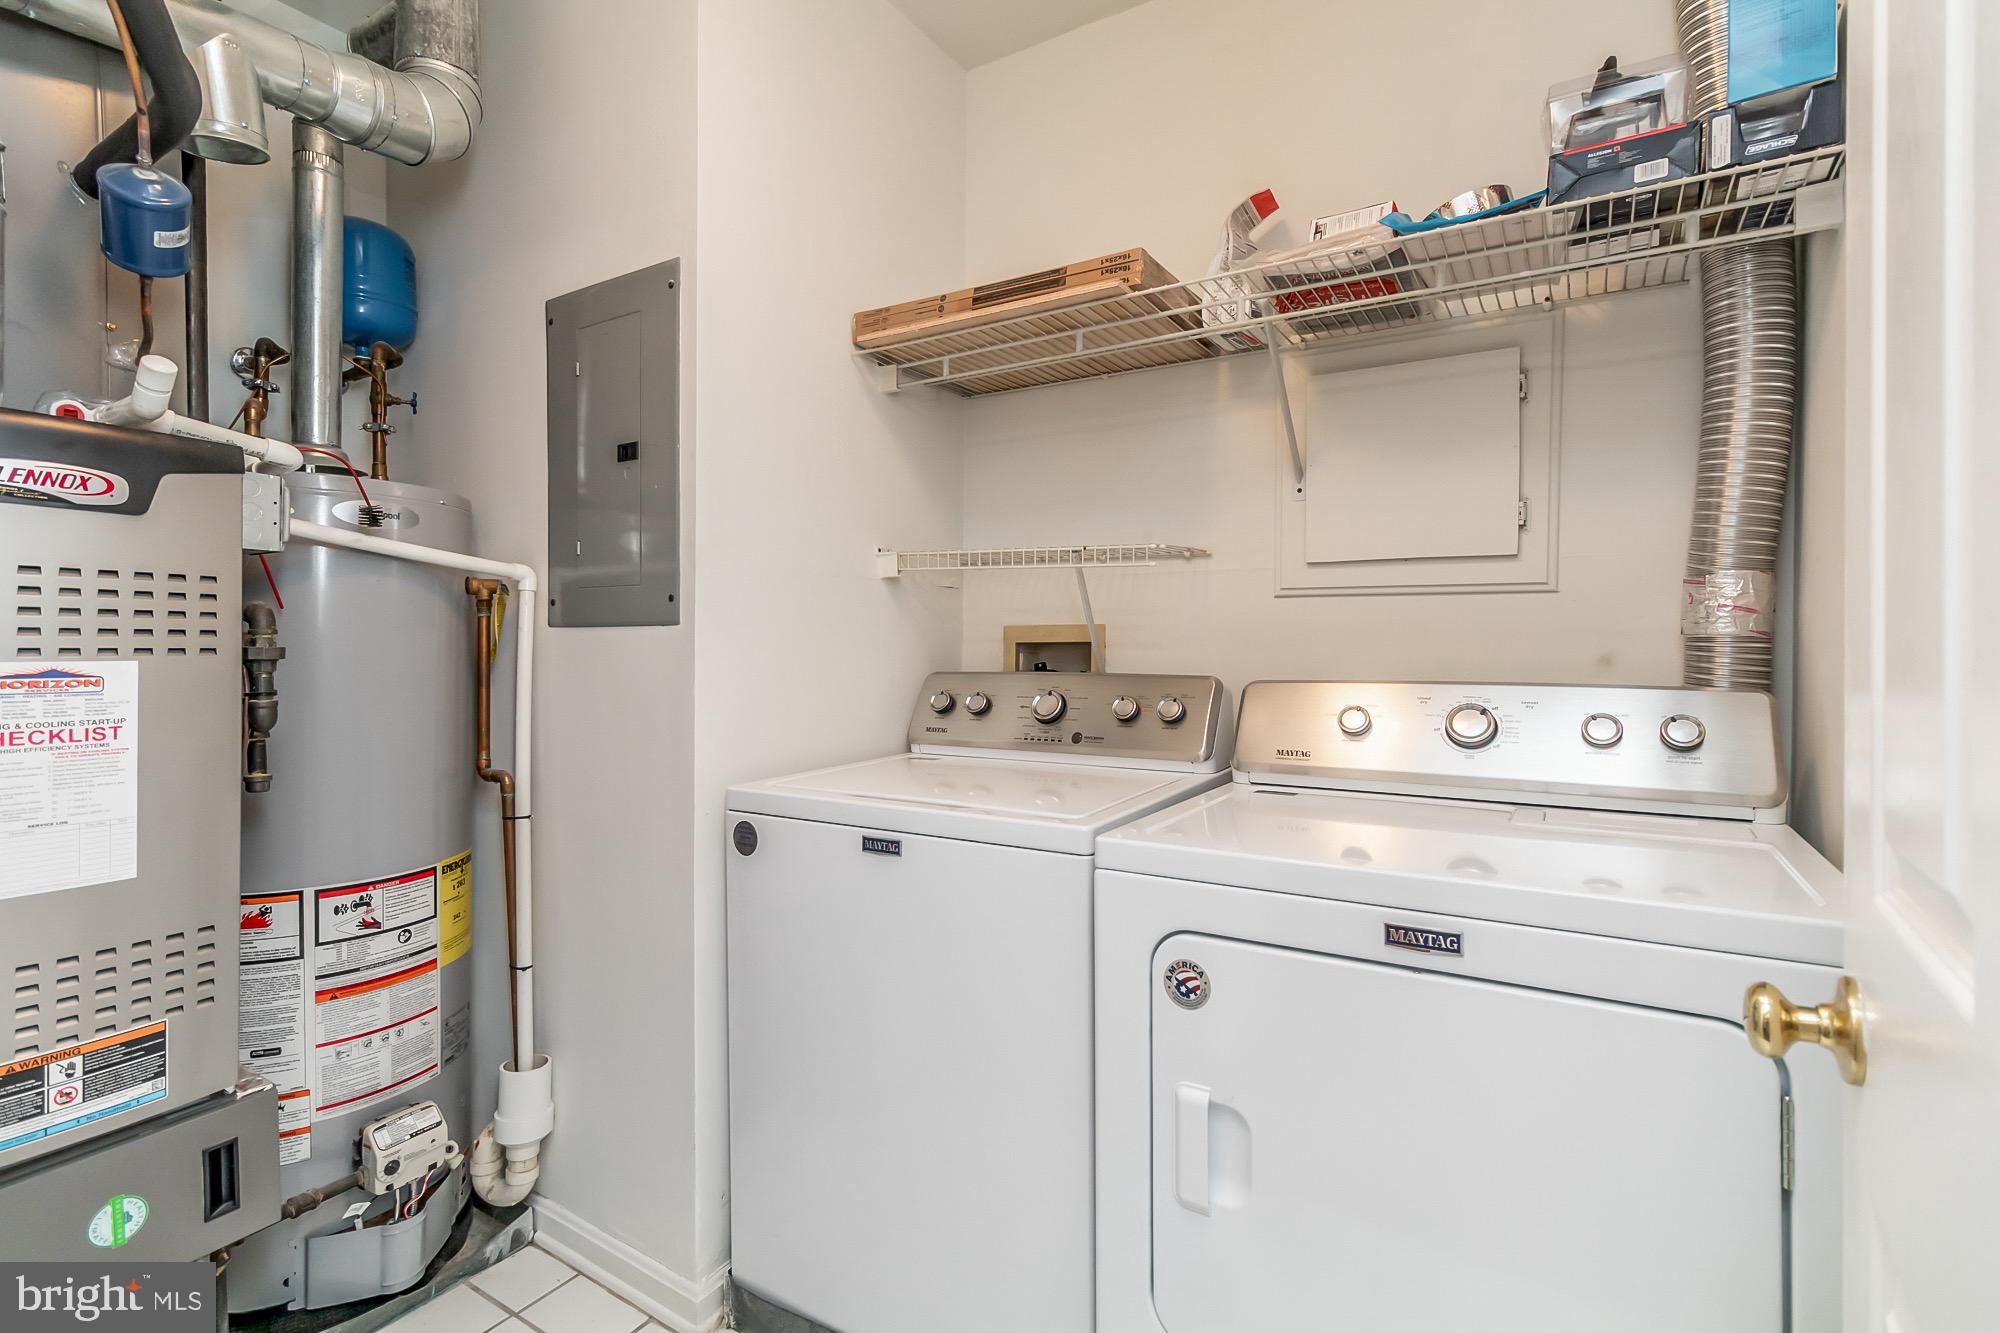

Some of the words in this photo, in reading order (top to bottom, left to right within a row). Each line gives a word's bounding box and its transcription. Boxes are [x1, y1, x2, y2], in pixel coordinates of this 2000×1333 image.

[1748, 138, 1797, 153] SCHLAGE
[1100, 253, 1131, 266] 16x25x1
[1100, 265, 1131, 276] 16x25x1
[25, 720, 76, 730] COOLING
[78, 718, 127, 728] START-UP
[0, 726, 123, 747] ECKLIST
[24, 745, 72, 753] EFFICIENCY
[74, 742, 110, 750] SYSTEMS
[1275, 749, 1311, 758] MAYTAG
[864, 839, 900, 852] MAYTAG
[1388, 928, 1459, 950] MAYTAG
[1166, 961, 1204, 983] AMERICA
[19, 1047, 82, 1070] WARNING
